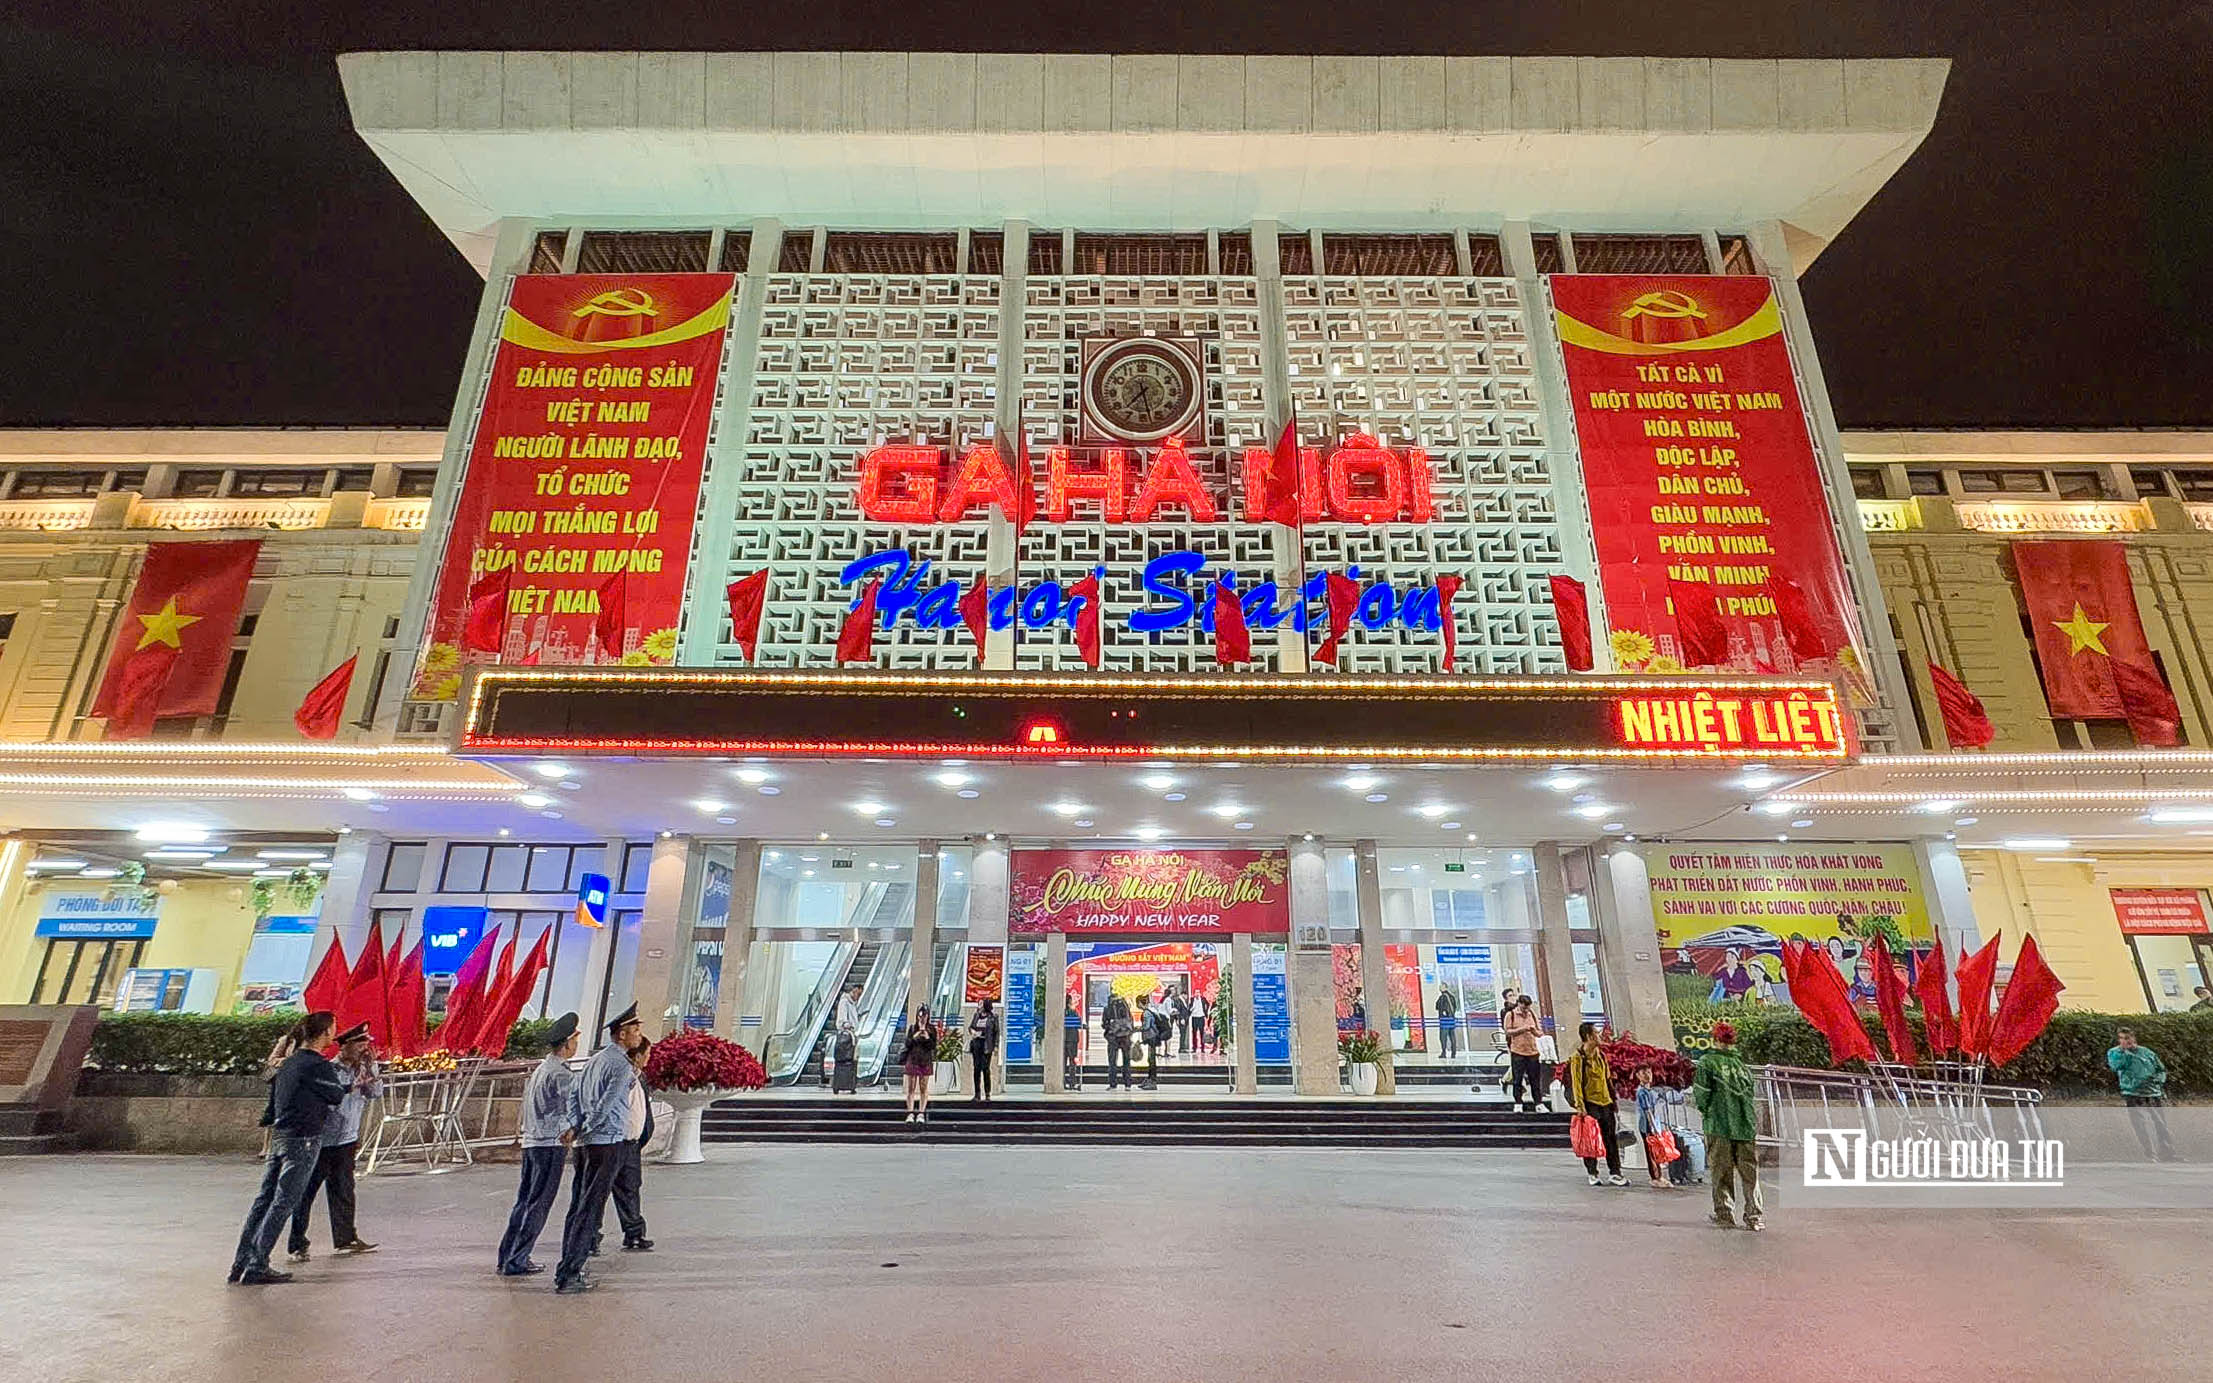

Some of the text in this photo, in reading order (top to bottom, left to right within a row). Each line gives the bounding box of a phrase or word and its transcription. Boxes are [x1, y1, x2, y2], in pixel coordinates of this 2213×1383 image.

[515, 359, 694, 393] ĐẢNG CỘNG SẢN
[1635, 361, 1724, 385] TẤT CẢ VÌ
[546, 397, 650, 429] VIỆT NAM
[1590, 389, 1784, 415] MỘT NƯỚC VIỆT NAM
[1644, 416, 1741, 441] HÒA BÌNH,
[494, 431, 683, 464] NGƯỜI LÃNH ĐẠO,
[1655, 444, 1740, 470] ĐỘC LẬP,
[536, 465, 631, 496] TỔ CHỨC
[859, 443, 1020, 524] GA
[1047, 434, 1216, 525] HÀ
[1658, 471, 1751, 497] DÂN CHỦ,
[489, 504, 660, 540] MỌI THẮNG LỢI
[1650, 500, 1771, 528] GIÀU MẠNH,
[1658, 530, 1776, 556] PHỒN VINH,
[523, 544, 587, 573] CÁCH
[1621, 691, 1838, 752] NHIỆT LIỆT
[1110, 854, 1131, 866] GA
[1024, 868, 1121, 914] Chúc
[1697, 900, 1717, 915] VAI
[103, 922, 138, 932] ROOM
[1076, 914, 1221, 928] HAPPY NEW YEAR
[431, 934, 458, 948] VIB
